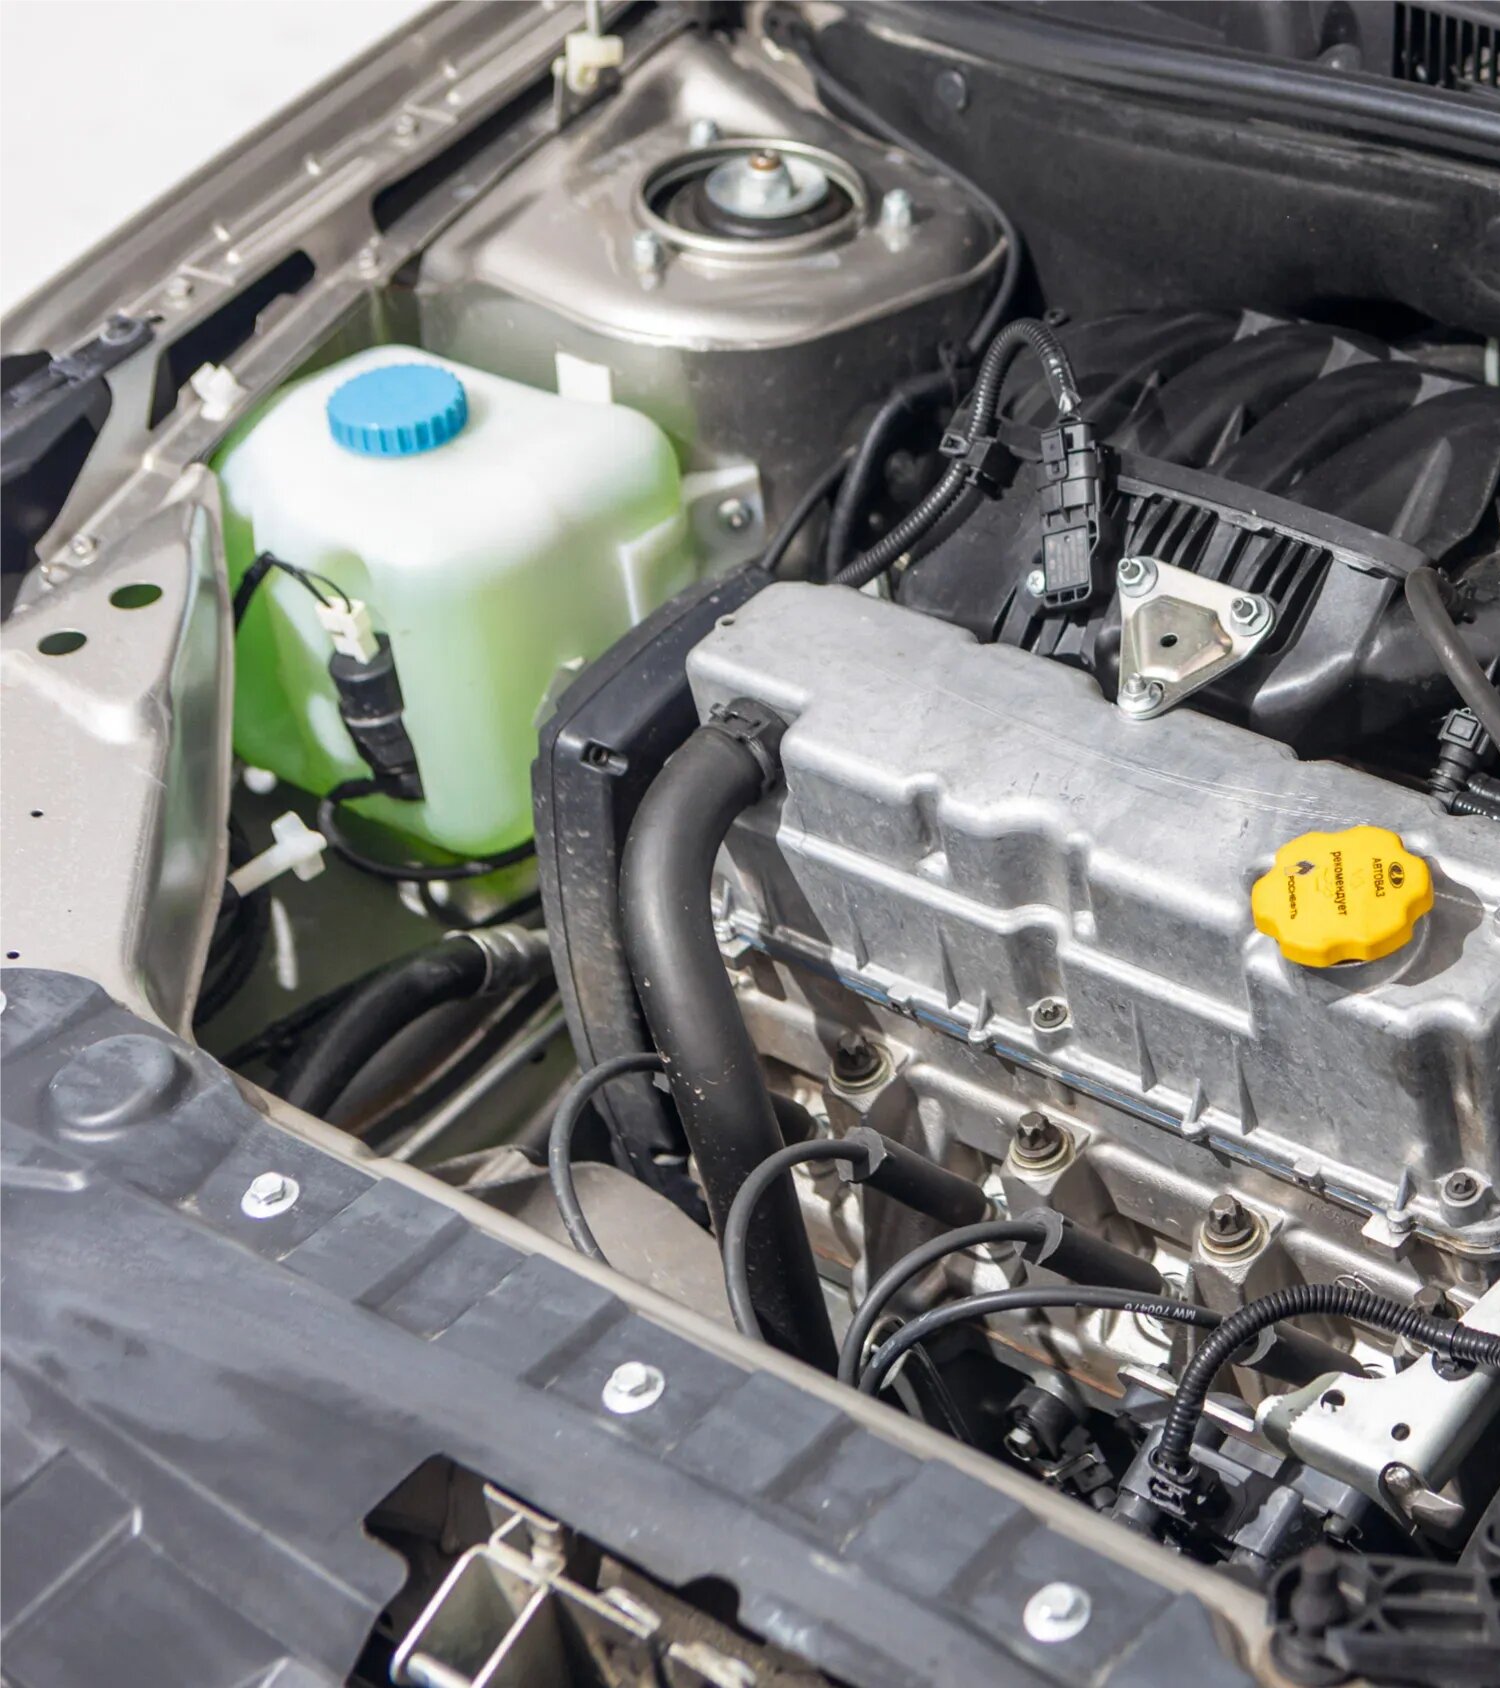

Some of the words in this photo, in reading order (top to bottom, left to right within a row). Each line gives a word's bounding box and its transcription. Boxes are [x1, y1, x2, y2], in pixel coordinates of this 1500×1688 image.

[1287, 875, 1297, 919] РОСНЕФТЬ
[1330, 851, 1348, 916] рекомендует
[1372, 857, 1386, 898] АВТОВАЗ
[1173, 1307, 1196, 1320] MW
